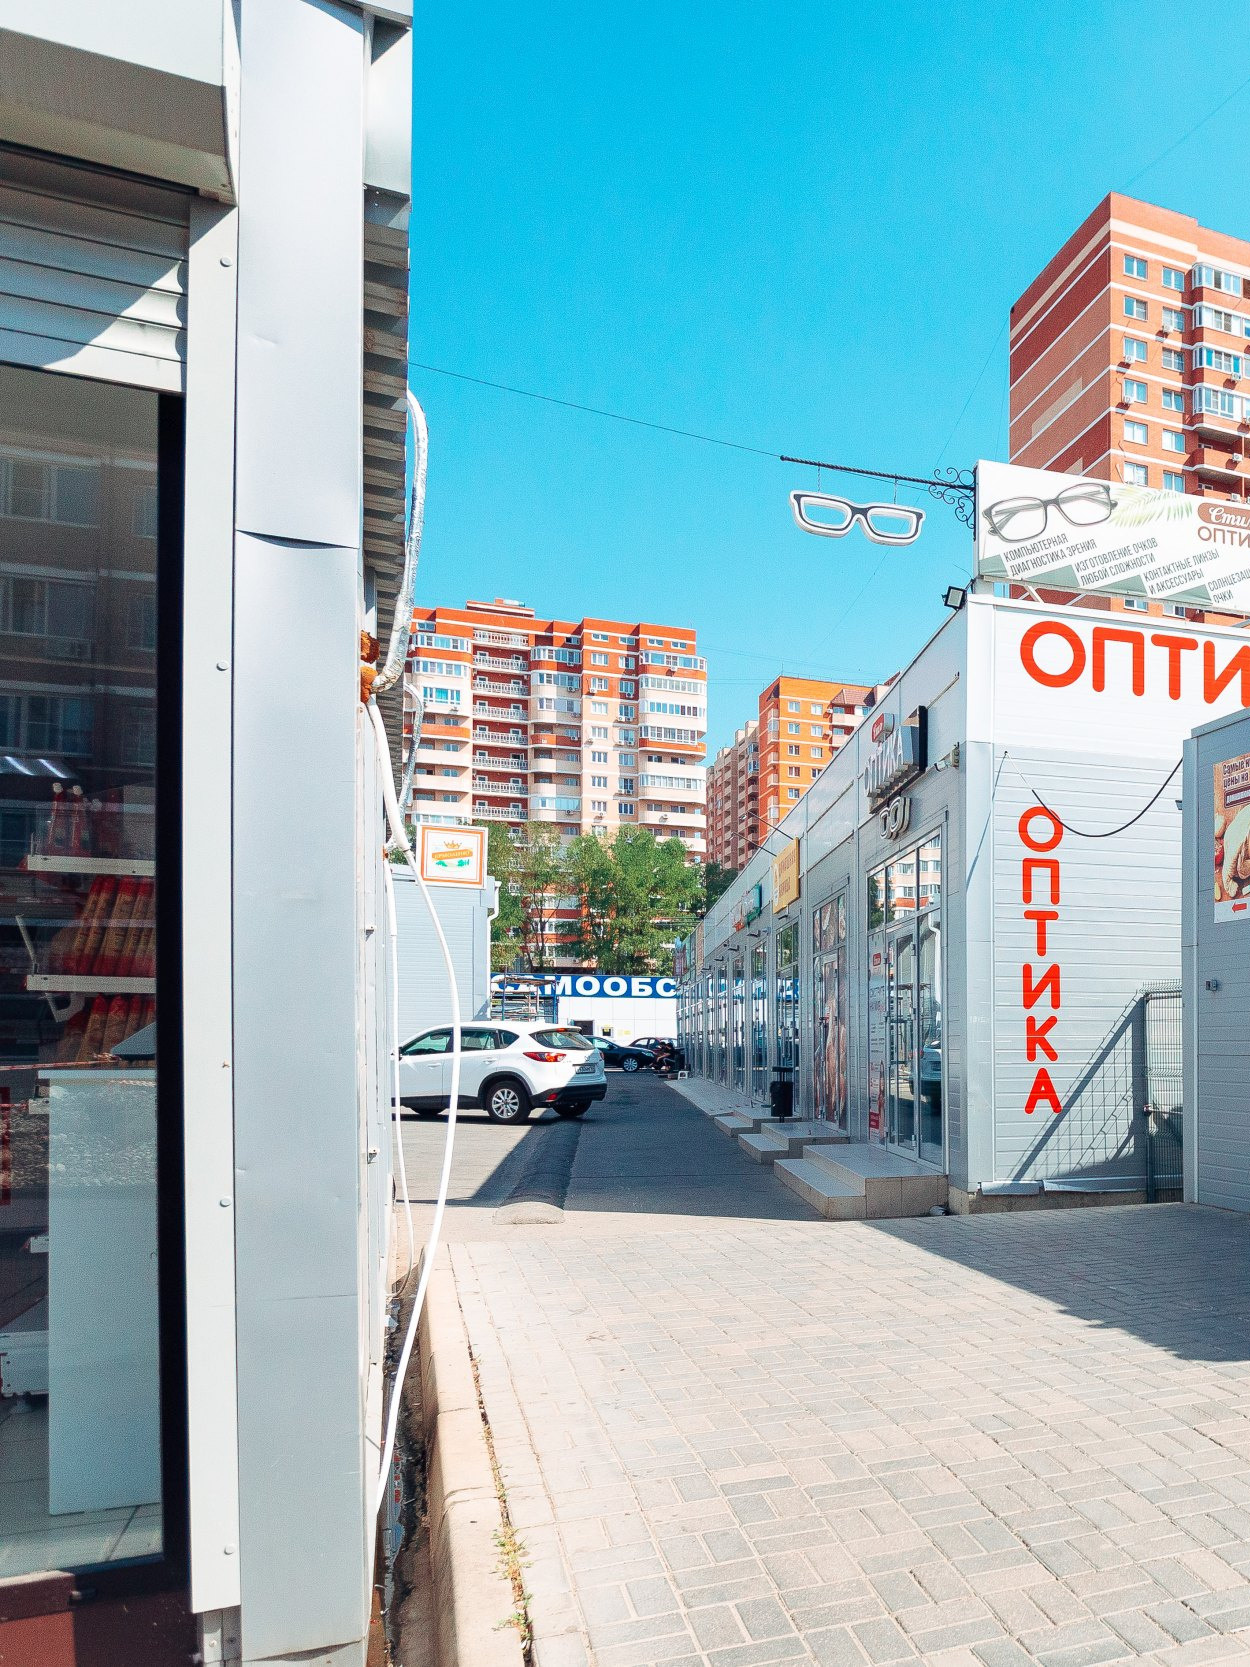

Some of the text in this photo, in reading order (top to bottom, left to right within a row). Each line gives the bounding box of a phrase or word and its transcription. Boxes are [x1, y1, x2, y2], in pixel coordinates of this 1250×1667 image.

[1004, 533, 1069, 562] КОМПЬЮТЕРНАЯ
[1010, 539, 1098, 577] ДИАГНОСТИКА ЗРЕНИЯ
[1075, 537, 1159, 572] ИЗГОТОВЛЕНИЕ ОЧКОВ
[1080, 553, 1155, 587] ЛЮБОЙ СЛОЖНОСТИ
[1144, 548, 1220, 582] КОНТАКТНЫЕ ЛИНЗЫ
[1156, 569, 1205, 594] АКСЕССУАРЫ
[1213, 589, 1234, 604] ОЧКИ
[1222, 759, 1245, 776] Самые
[1223, 772, 1249, 789] цены на
[1018, 806, 1063, 1114] ОПТИКА
